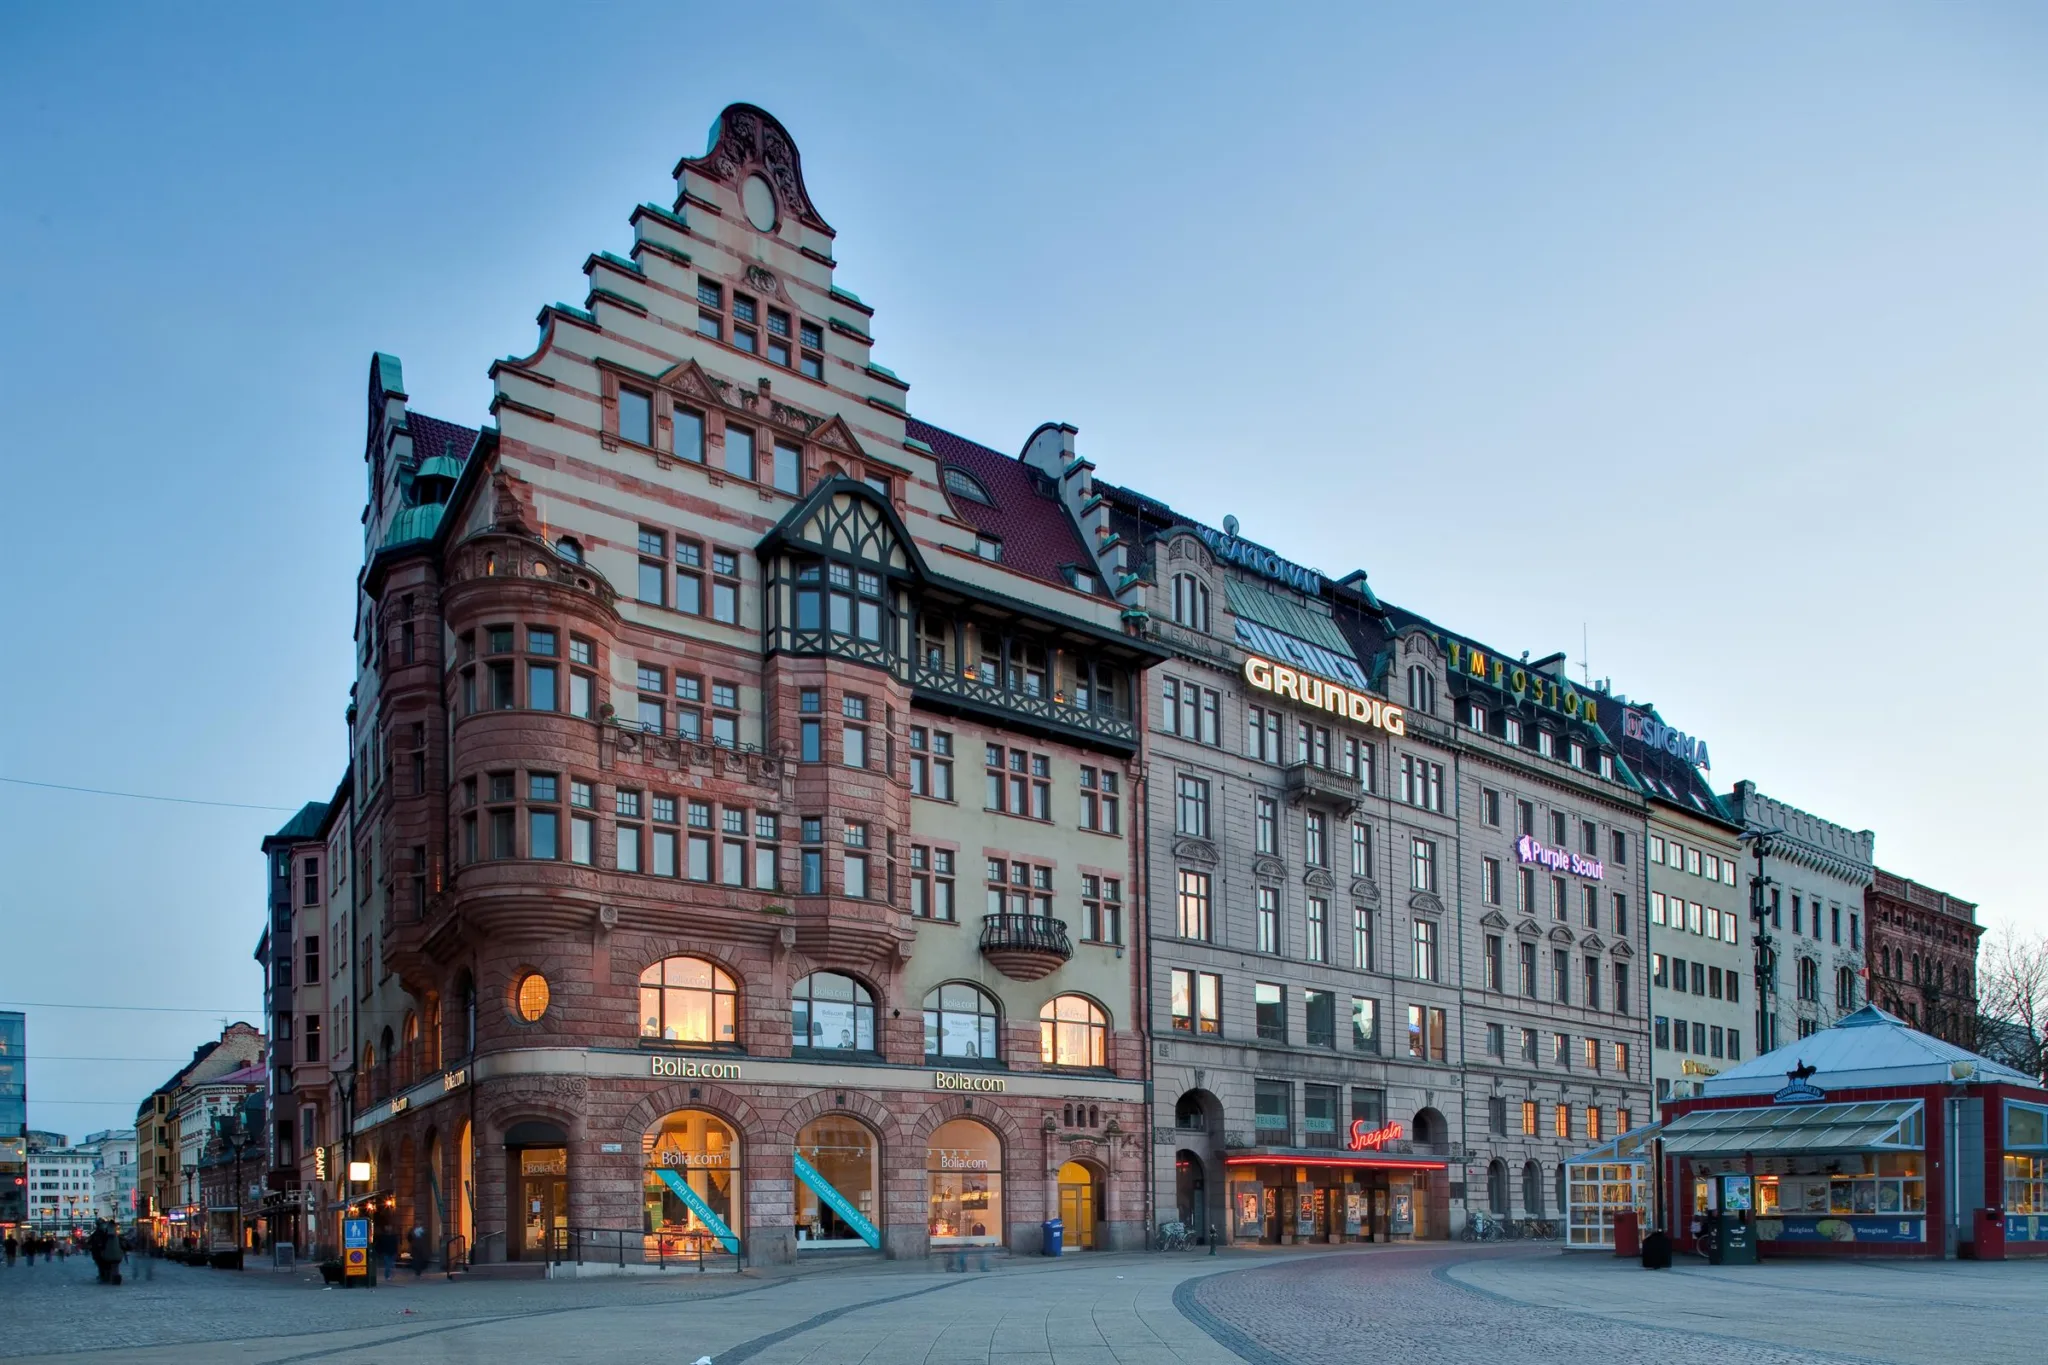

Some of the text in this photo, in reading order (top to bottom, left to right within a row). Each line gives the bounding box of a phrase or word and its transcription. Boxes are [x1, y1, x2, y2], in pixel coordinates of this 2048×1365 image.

[1196, 525, 1320, 596] VASAKRONAN
[1171, 627, 1212, 653] BANK
[1433, 635, 1597, 723] YMPOSION
[1245, 656, 1405, 736] GRUNDIG
[1641, 716, 1711, 771] SIGMA
[1533, 841, 1604, 880] Purple Scout
[814, 985, 853, 999] Bolia.com
[943, 998, 976, 1009] Bolia.com
[652, 1056, 741, 1079] Bolia.com
[936, 1071, 1005, 1092] Bolia.com
[1349, 1119, 1402, 1151] Spegeln
[316, 1147, 325, 1181] GRANIT
[662, 1151, 722, 1164] Bolia.com
[941, 1156, 988, 1168] Bolia.com
[673, 1180, 726, 1236] FRI LEVERANS
